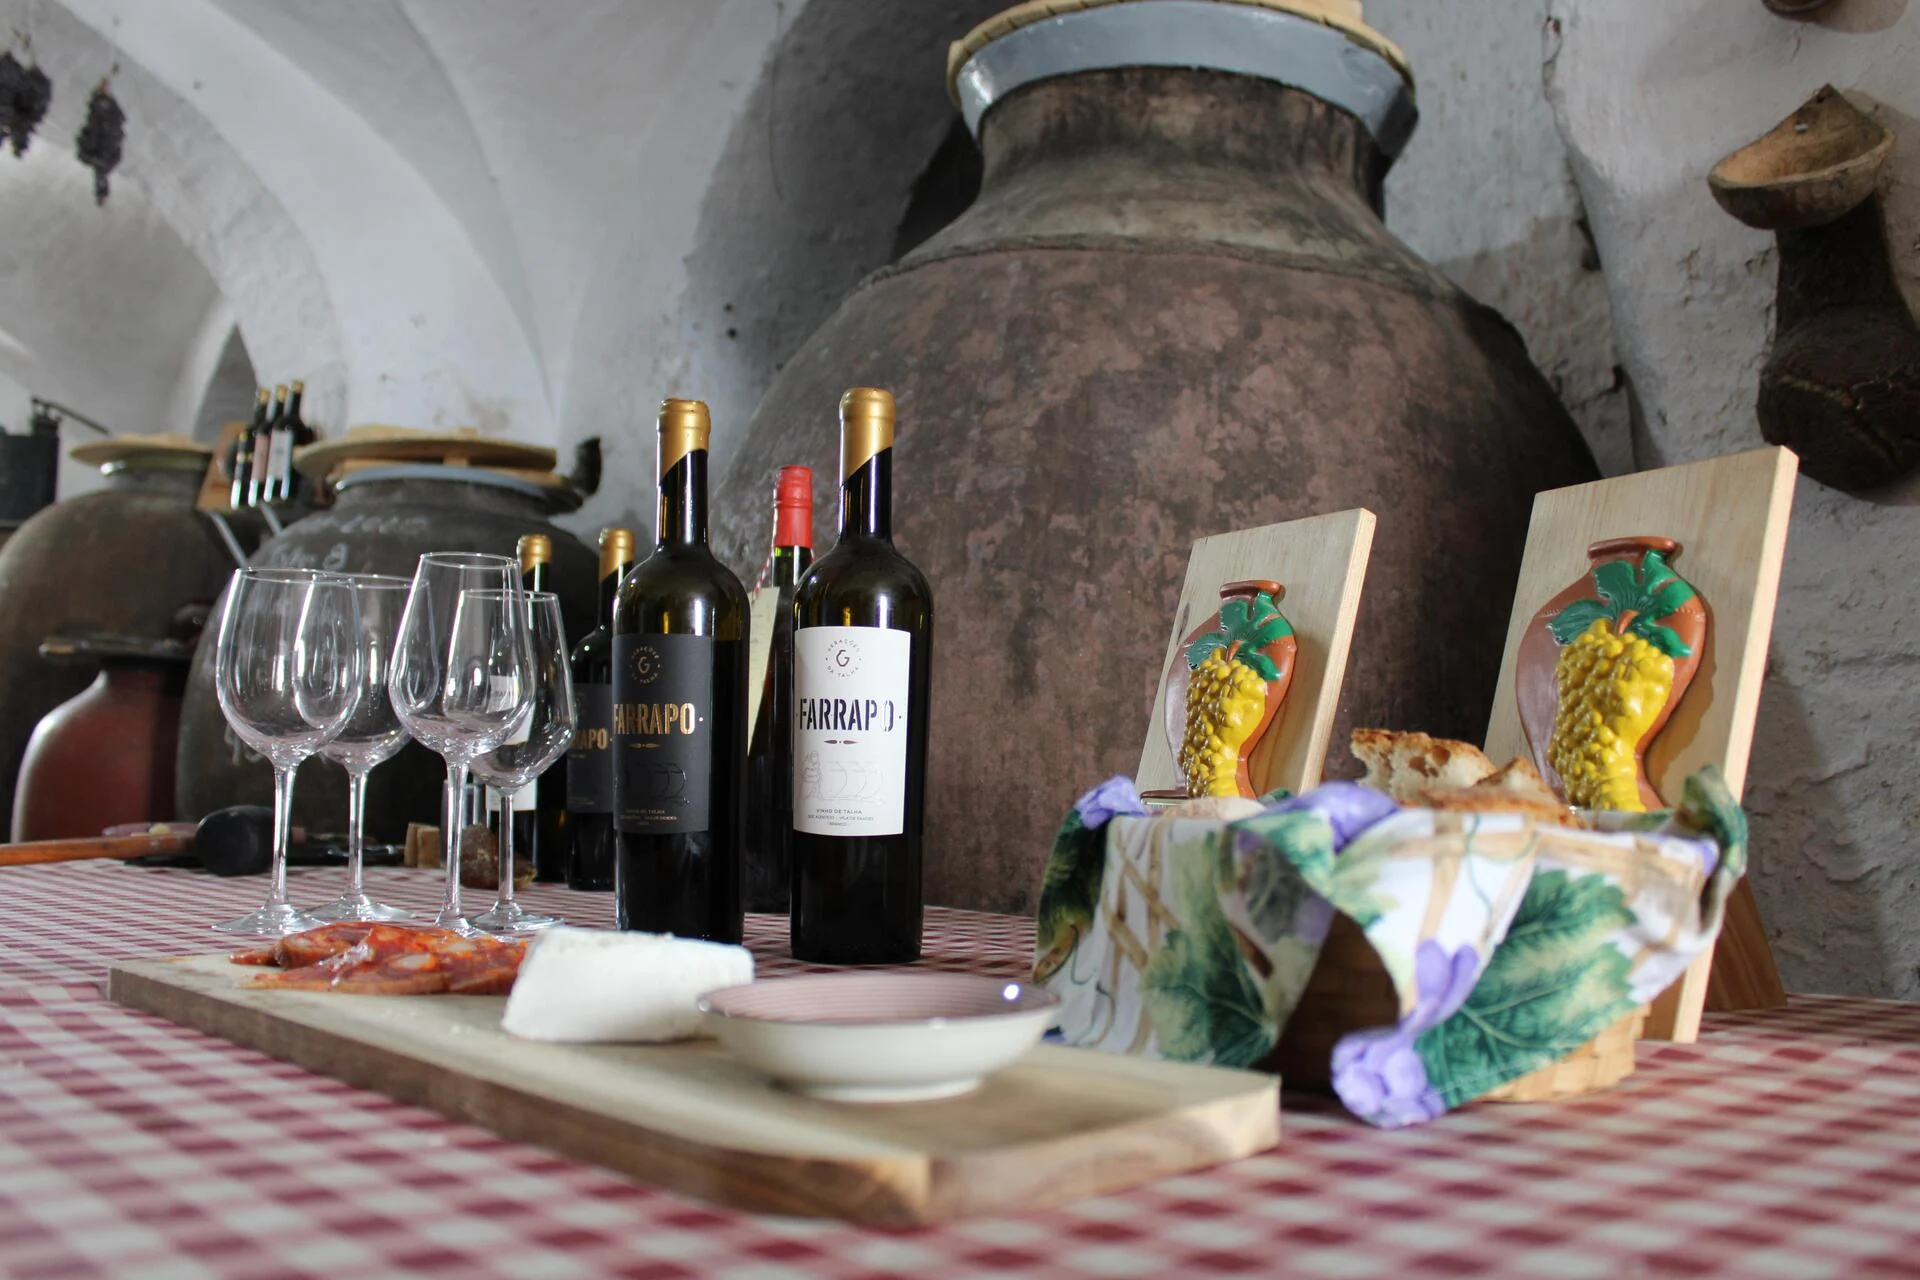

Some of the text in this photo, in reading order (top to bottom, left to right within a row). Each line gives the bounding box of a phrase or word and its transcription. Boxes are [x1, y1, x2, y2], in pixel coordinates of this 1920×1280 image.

[638, 656, 650, 674] G
[836, 649, 850, 667] G
[613, 703, 696, 735] FARRAPO
[800, 698, 894, 732] FARRAPO
